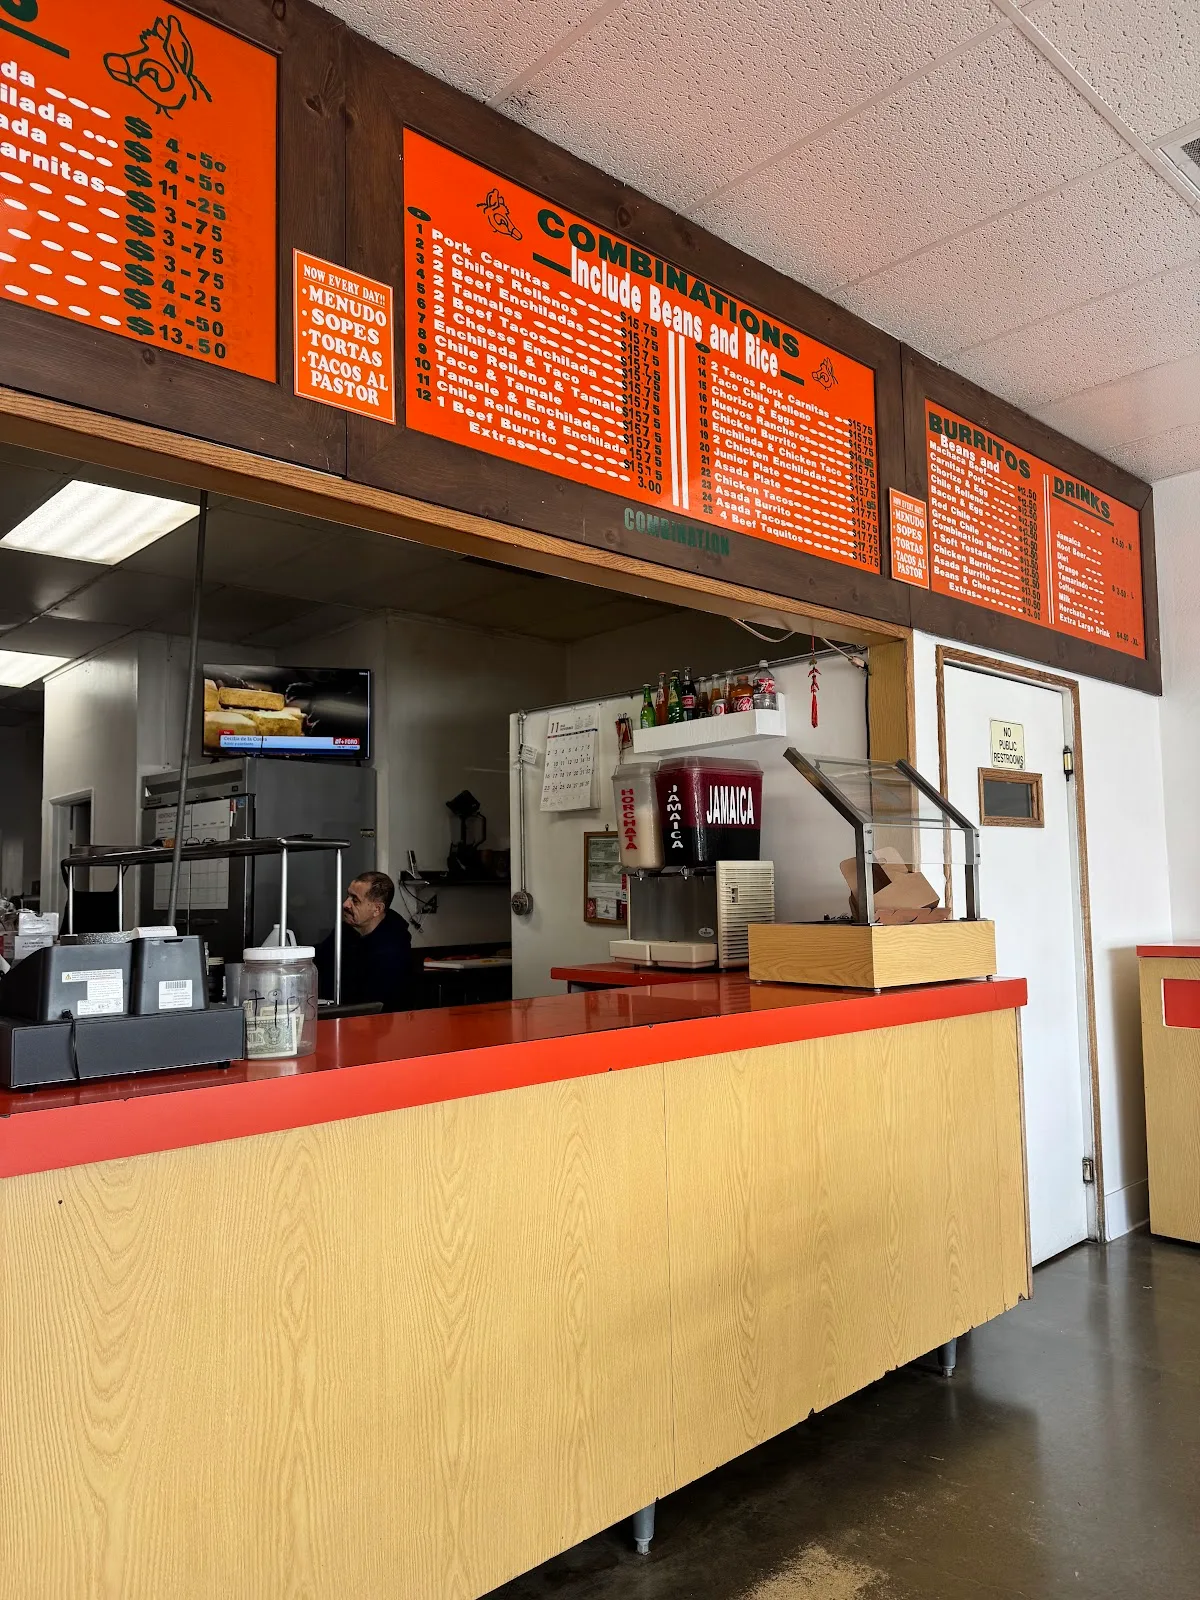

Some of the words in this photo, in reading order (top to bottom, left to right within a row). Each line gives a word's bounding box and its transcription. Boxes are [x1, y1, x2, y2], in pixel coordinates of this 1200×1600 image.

[432, 228, 472, 256] Pork
[481, 251, 550, 290] Carnitas
[304, 264, 325, 283] NOW
[329, 274, 359, 295] EVERY
[363, 287, 385, 306] DAY!!
[433, 244, 443, 257] 2
[452, 253, 504, 284] Chiles
[511, 279, 578, 316] Rellenos
[433, 259, 443, 272] 2
[452, 267, 491, 293] Beef
[499, 287, 584, 332] Enchiladas
[433, 274, 444, 287] 2
[452, 281, 522, 320] Tamales
[537, 209, 799, 357] COMBINATIONS
[309, 285, 386, 327] MENUDO
[434, 289, 444, 302] 2
[453, 296, 492, 322] Beef
[499, 316, 547, 344] Tacos
[571, 245, 641, 313] Include
[650, 284, 702, 342] Beans
[710, 324, 738, 359] and
[746, 332, 778, 377] Rice
[312, 308, 379, 345] SOPES
[434, 304, 444, 317] 2
[453, 312, 516, 345] Cheese
[523, 340, 596, 378] Enchilada
[308, 329, 382, 367] TORTAS
[434, 319, 517, 360] Enchilada
[525, 356, 536, 368] &
[543, 362, 579, 384] Taco
[308, 351, 362, 382] TACOS
[367, 371, 388, 391] AL
[311, 370, 379, 406] PASTOR
[435, 335, 478, 359] Chile
[487, 354, 547, 385] Relleno
[554, 381, 564, 392] &
[571, 386, 623, 414] Tamale
[435, 349, 478, 374] Taco
[486, 369, 497, 382] &
[505, 375, 562, 405] Tamale
[711, 361, 718, 371] 2
[722, 366, 755, 387] Tacos
[760, 382, 783, 399] Pork
[788, 394, 829, 418] Carnitas
[436, 364, 499, 396] Tamale
[507, 392, 518, 404] &
[526, 398, 600, 433] Enchilada
[711, 373, 738, 391] Taco
[743, 387, 769, 404] Chile
[774, 400, 811, 421] Relleno
[712, 386, 754, 409] Chorizo
[759, 405, 765, 415] &
[771, 410, 795, 426] Eggs
[437, 381, 477, 402] Chile
[485, 397, 540, 424] Relleno
[547, 420, 556, 431] &
[563, 425, 627, 455] Enchilada
[437, 396, 444, 407] 1
[453, 400, 493, 423] Beef
[501, 417, 556, 445] Burrito
[470, 421, 525, 448] Extras
[712, 397, 752, 420] Huevos
[757, 415, 810, 443] Rancheros
[712, 410, 756, 434] Chicken
[761, 429, 797, 449] Burrito
[712, 422, 763, 448] Enchilada
[768, 443, 774, 452] &
[779, 447, 817, 467] Chicken
[820, 462, 841, 476] Taco
[713, 434, 720, 444] 2
[725, 439, 768, 461] Chicken
[773, 456, 826, 482] Enchiladas
[714, 447, 748, 465] Junior
[753, 460, 779, 477] Plate
[929, 411, 1030, 479] BURRITOS
[941, 434, 975, 461] Beans
[981, 457, 999, 473] and
[715, 460, 749, 478] Asada
[754, 472, 780, 488] Plate
[930, 452, 965, 475] Carnitas
[968, 470, 986, 485] Pork
[931, 464, 961, 484] Chorizo
[974, 484, 988, 497] Egg
[715, 473, 759, 495] Chicken
[763, 489, 794, 506] Tacos
[716, 485, 750, 503] Asada
[755, 498, 791, 517] Burrito
[931, 475, 951, 490] Chile
[955, 485, 983, 505] Relleno
[931, 485, 956, 503] Bacon
[969, 502, 983, 516] Egg
[1054, 476, 1110, 519] DRINKS
[716, 497, 750, 515] Asada
[755, 509, 787, 527] Tacos
[720, 511, 727, 520] 4
[732, 513, 756, 528] Beef
[760, 523, 803, 542] Taquitos
[895, 509, 924, 528] MENUDO
[931, 497, 947, 511] Red
[951, 506, 970, 520] Chile
[932, 509, 956, 526] Green
[960, 521, 979, 535] Chile
[624, 508, 729, 556] COMBINATION
[896, 523, 922, 541] SOPES
[896, 537, 923, 555] TORTAS
[932, 520, 984, 546] Combination
[987, 541, 1012, 557] Burrito
[933, 531, 937, 539] 1
[940, 534, 958, 547] Soft
[961, 541, 992, 560] Tostada
[1056, 531, 1081, 547] Jamaica
[1057, 541, 1071, 553] Root
[1073, 548, 1086, 560] Beer
[896, 551, 916, 566] TACOS
[918, 558, 926, 569] AL
[897, 562, 923, 579] PASTOR
[934, 544, 966, 562] Chicken
[969, 557, 996, 572] Burrito
[934, 555, 960, 570] Asada
[963, 565, 990, 581] Burrito
[934, 566, 959, 581] Beans
[972, 579, 1000, 594] Cheese
[949, 582, 976, 597] Extras
[1060, 613, 1076, 626] Extra
[1078, 620, 1094, 632] Large
[1096, 627, 1110, 638] Drink
[999, 740, 1017, 751] PUBLIC
[1004, 727, 1011, 737] NO
[994, 753, 1023, 765] RESTROOMS
[622, 788, 638, 850] HORCHATA
[667, 785, 683, 849] JAMAICA
[706, 786, 754, 825] JAMAICA
